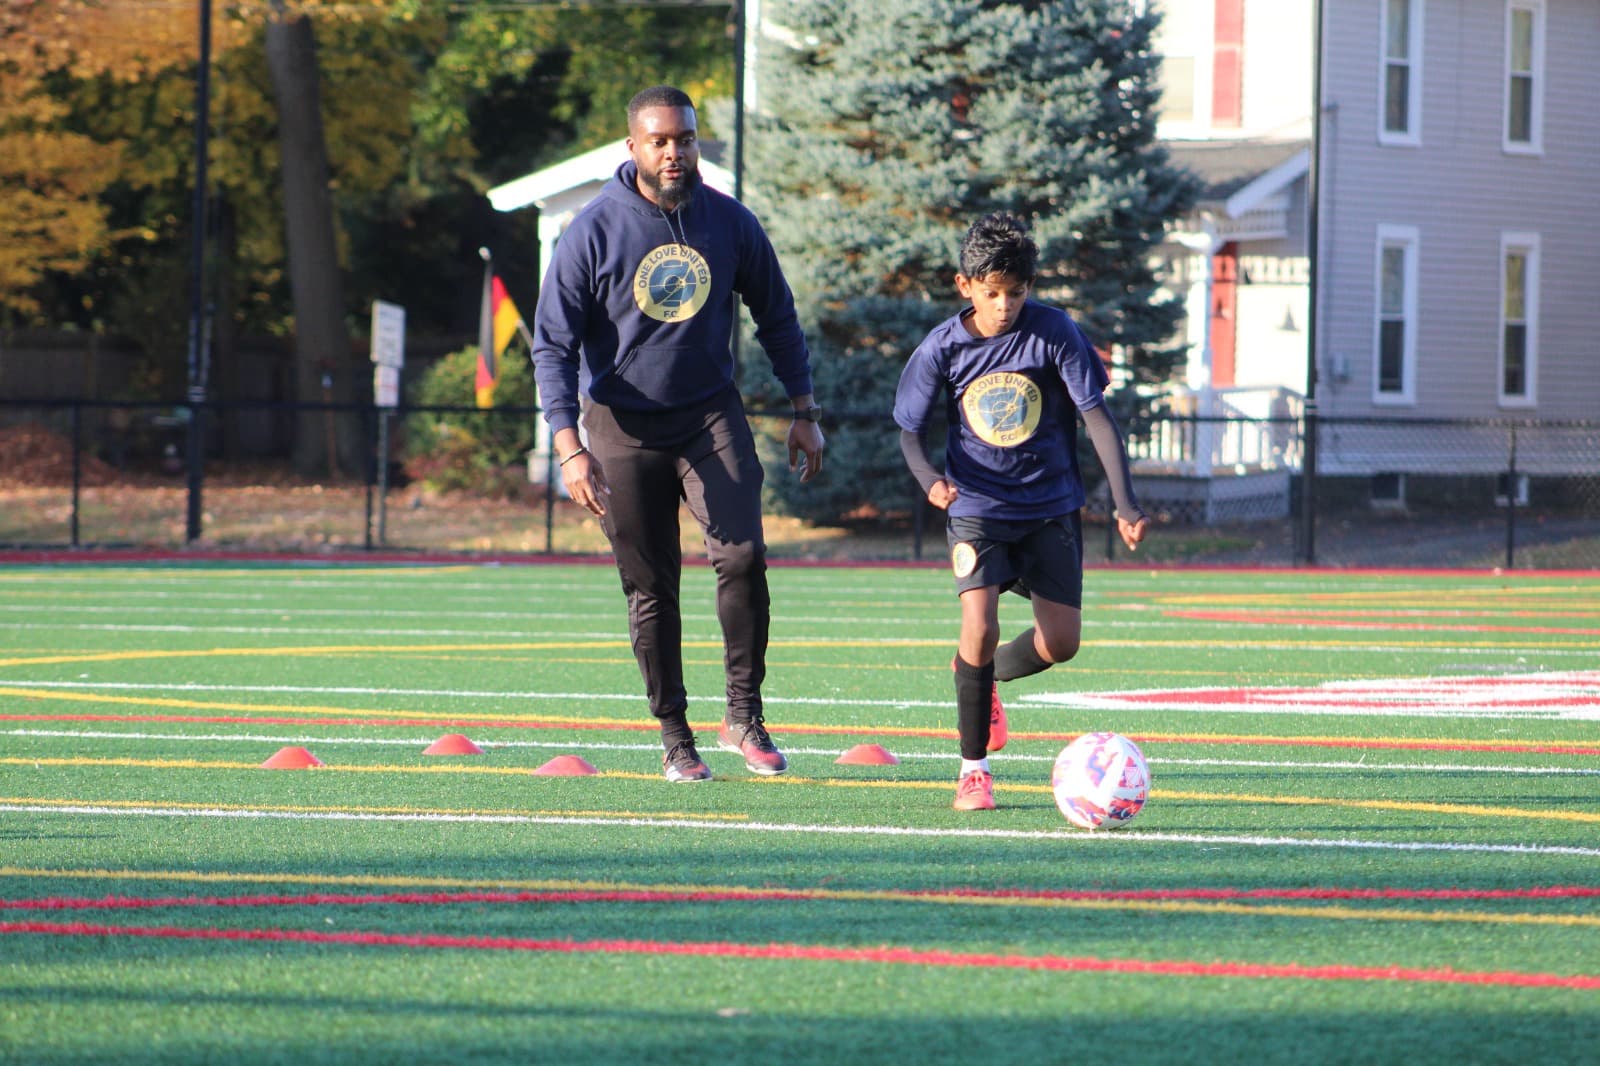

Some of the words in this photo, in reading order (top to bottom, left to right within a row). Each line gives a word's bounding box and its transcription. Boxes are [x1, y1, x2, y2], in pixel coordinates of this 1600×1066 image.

[638, 263, 652, 288] ONE
[649, 247, 677, 264] LOVE
[680, 248, 708, 285] UNITED
[1005, 375, 1038, 402] UNITED
